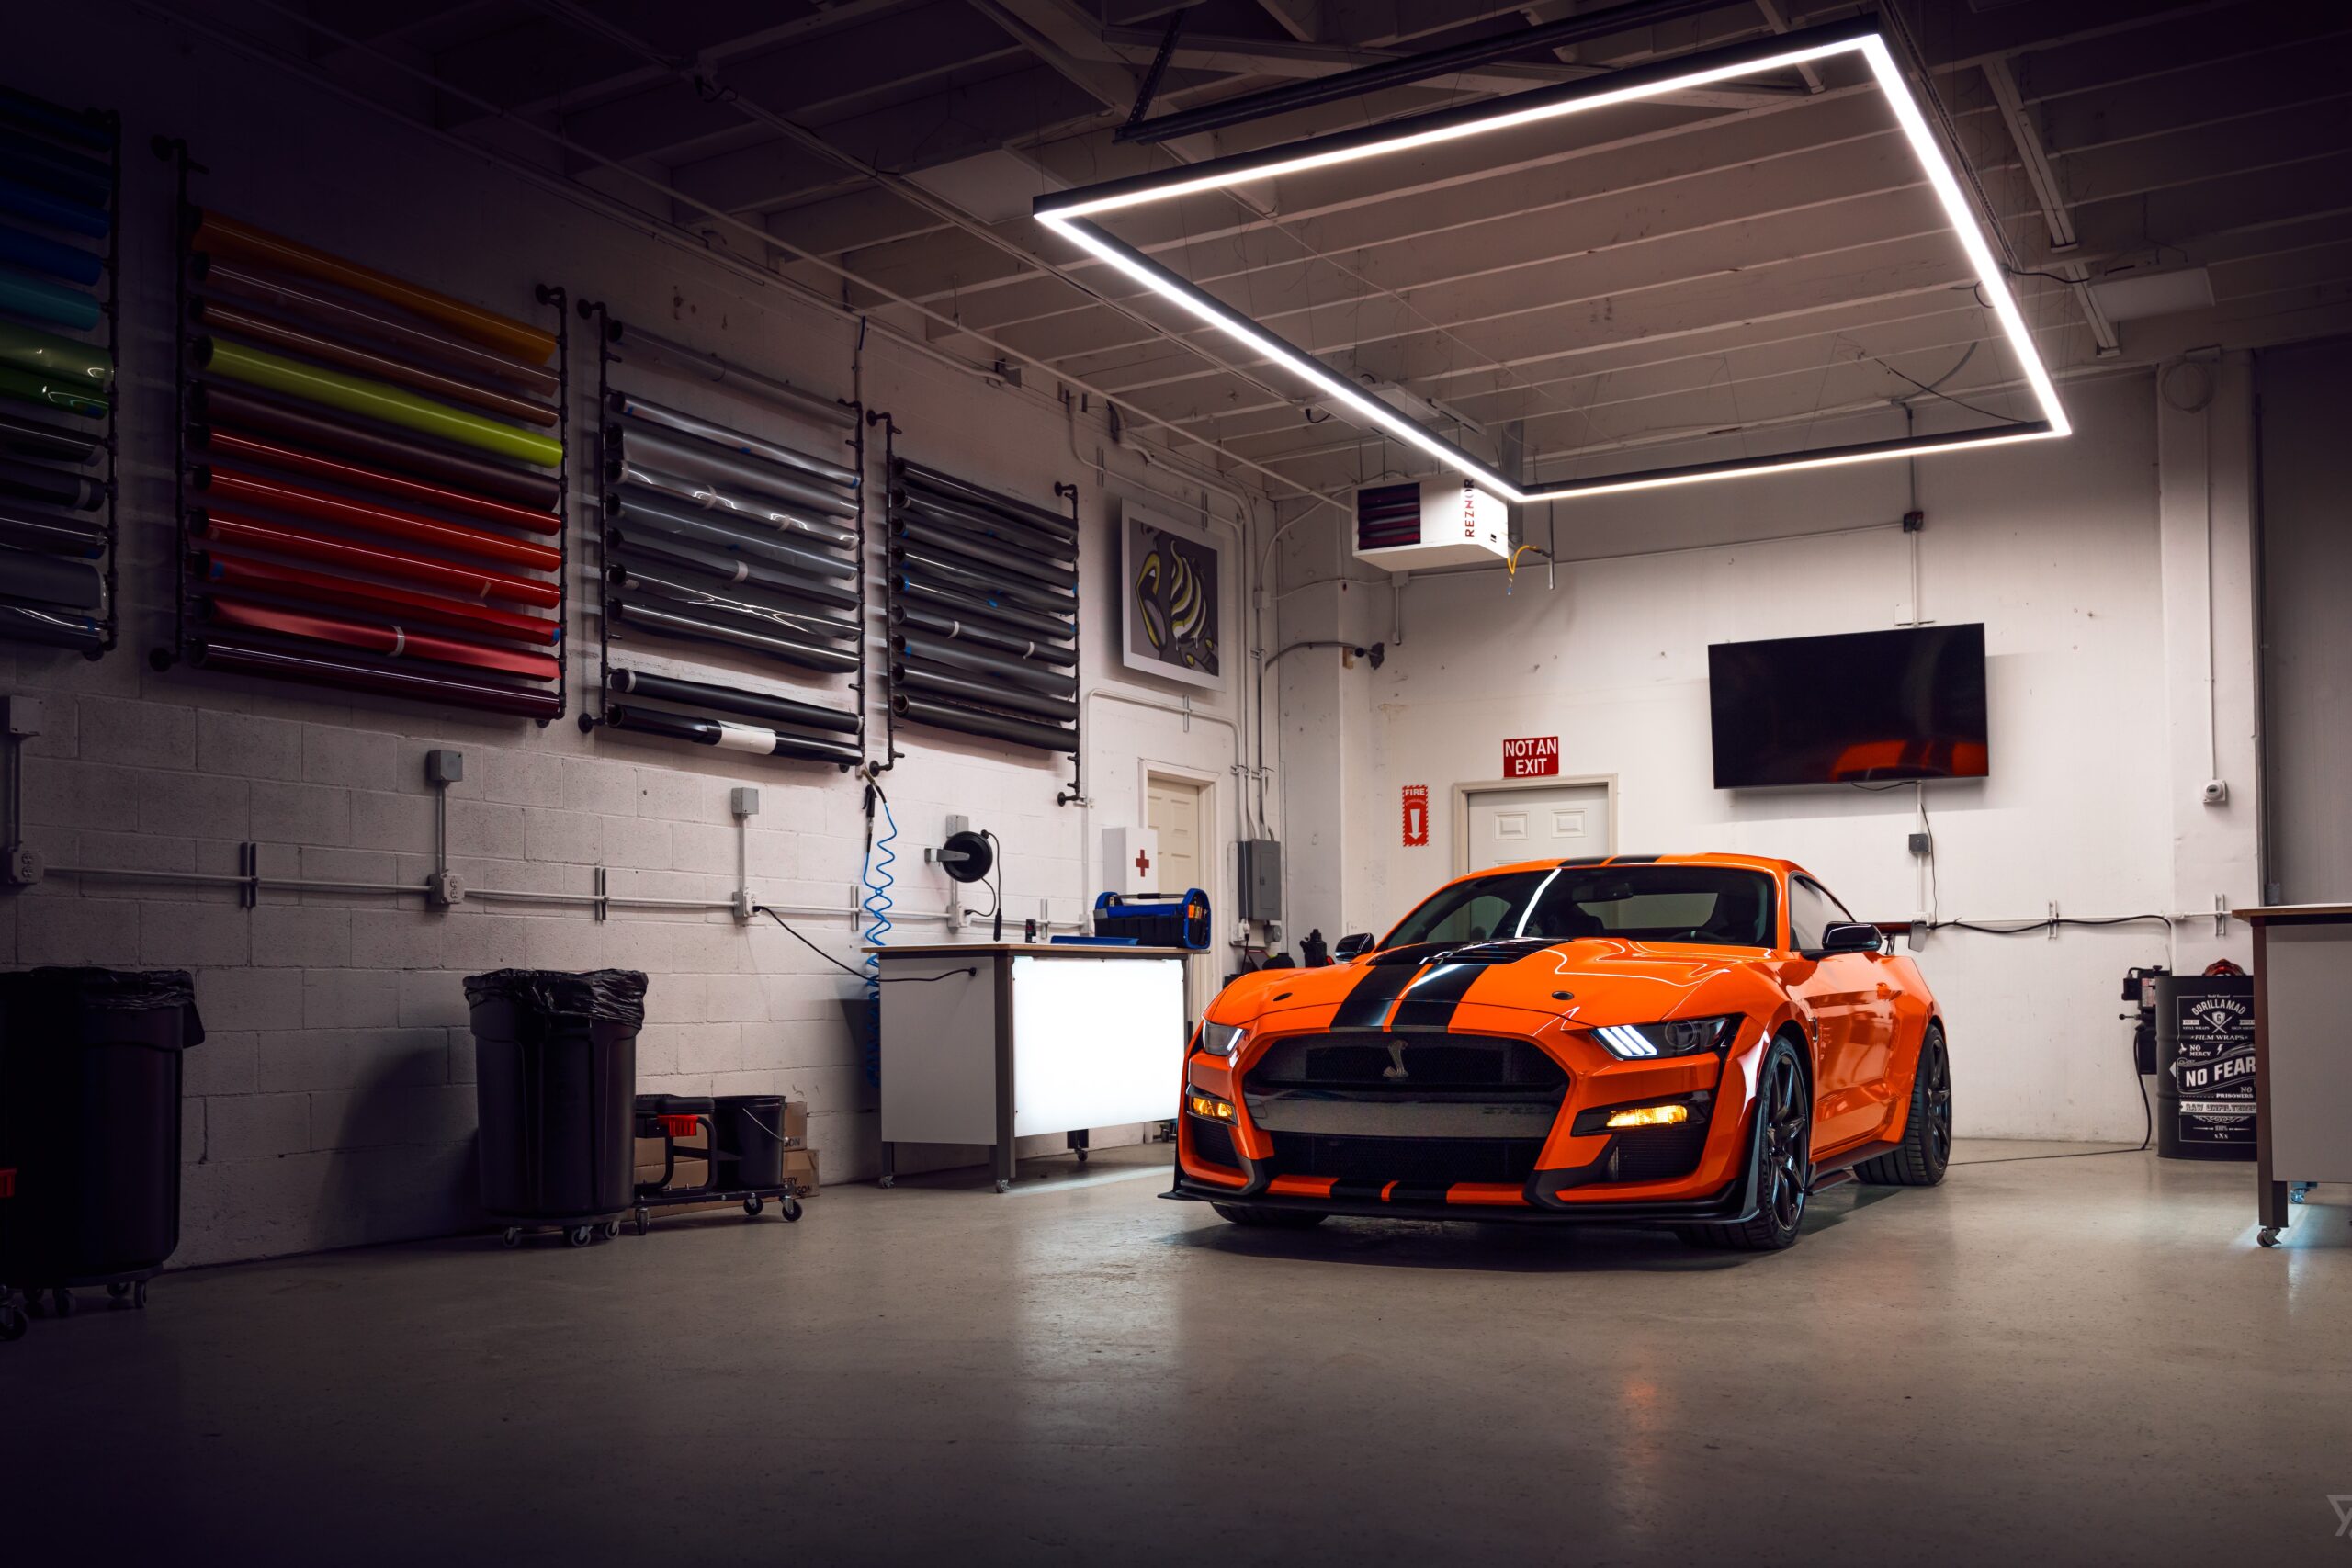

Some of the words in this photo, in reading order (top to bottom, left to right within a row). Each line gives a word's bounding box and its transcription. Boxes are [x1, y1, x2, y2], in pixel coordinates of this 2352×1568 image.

[1464, 479, 1475, 537] REZNOR
[1505, 739, 1534, 757] NOT
[1536, 739, 1557, 755] AN
[1516, 758, 1547, 775] EXIT
[1405, 788, 1426, 796] FIRE
[2186, 1068, 2208, 1088] NO
[2214, 1056, 2256, 1081] FEAR
[2186, 1103, 2204, 1111] RAW
